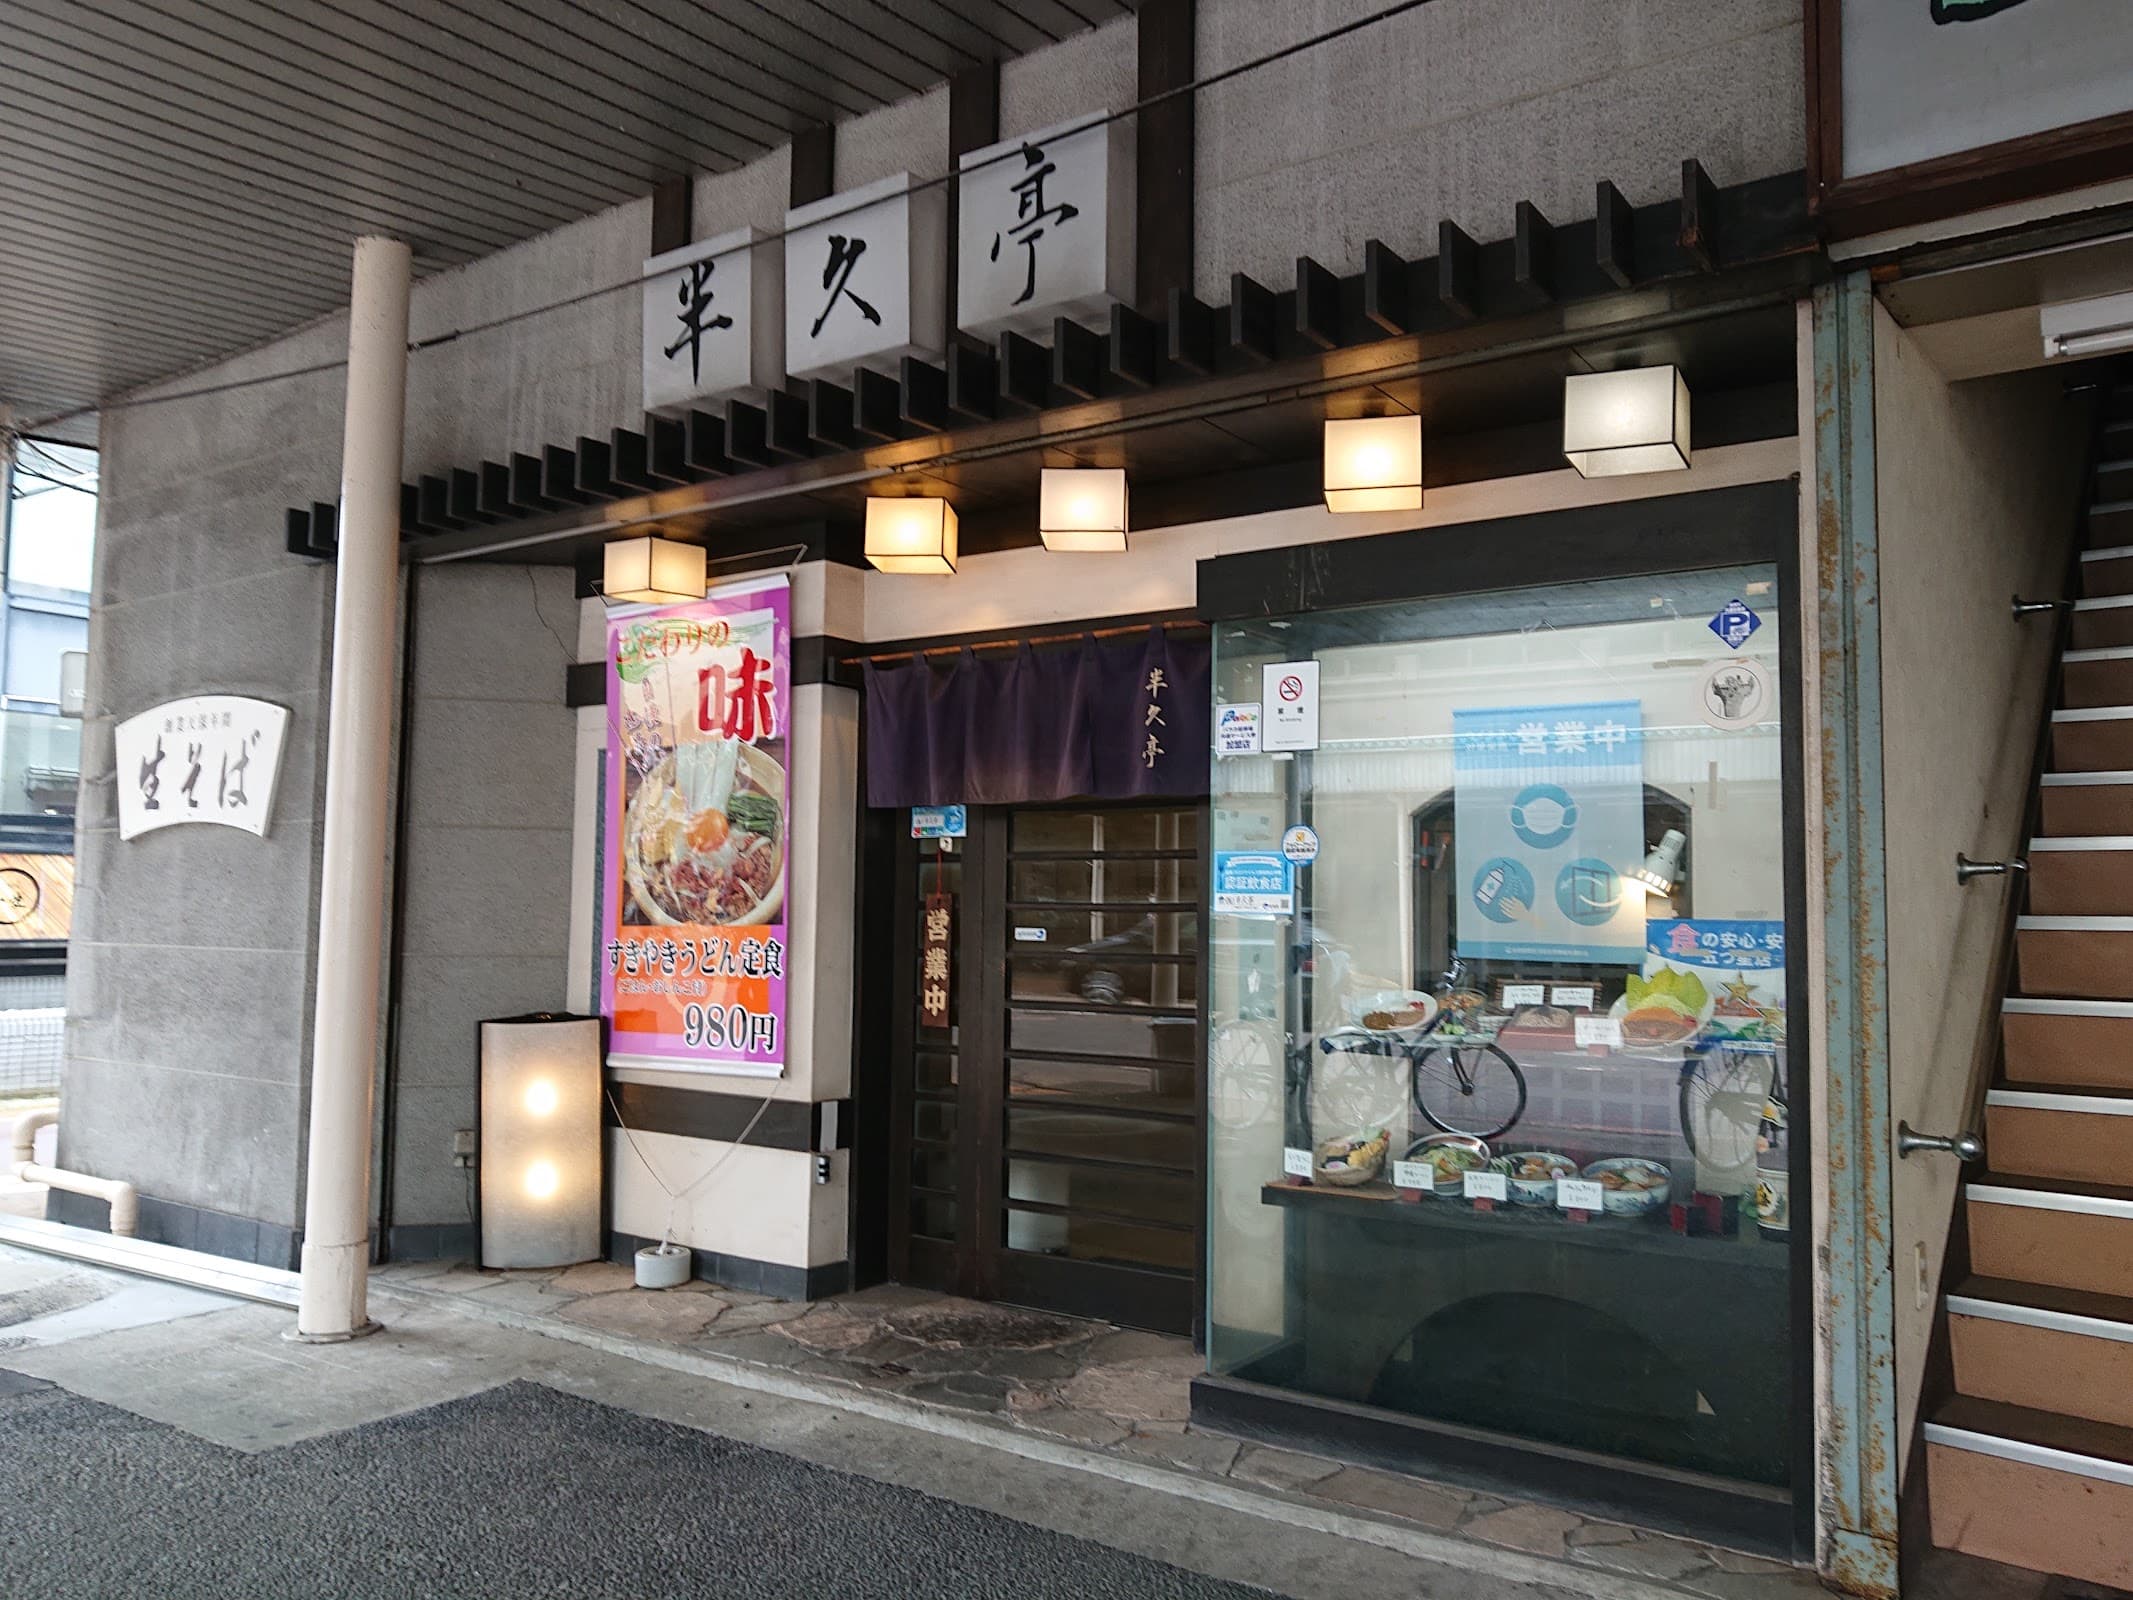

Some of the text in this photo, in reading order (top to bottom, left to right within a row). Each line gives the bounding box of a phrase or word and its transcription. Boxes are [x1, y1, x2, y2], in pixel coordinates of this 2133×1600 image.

[663, 141, 1079, 387] 半久亭
[614, 619, 731, 664] こだわりの
[1722, 613, 1748, 636] P
[697, 646, 775, 740] 味
[1140, 667, 1169, 770] 半久亭
[1516, 720, 1627, 756] 営業中
[607, 937, 783, 978] すきやきうどん定食
[923, 906, 951, 1018] 営業中
[684, 1003, 776, 1052] 980円
